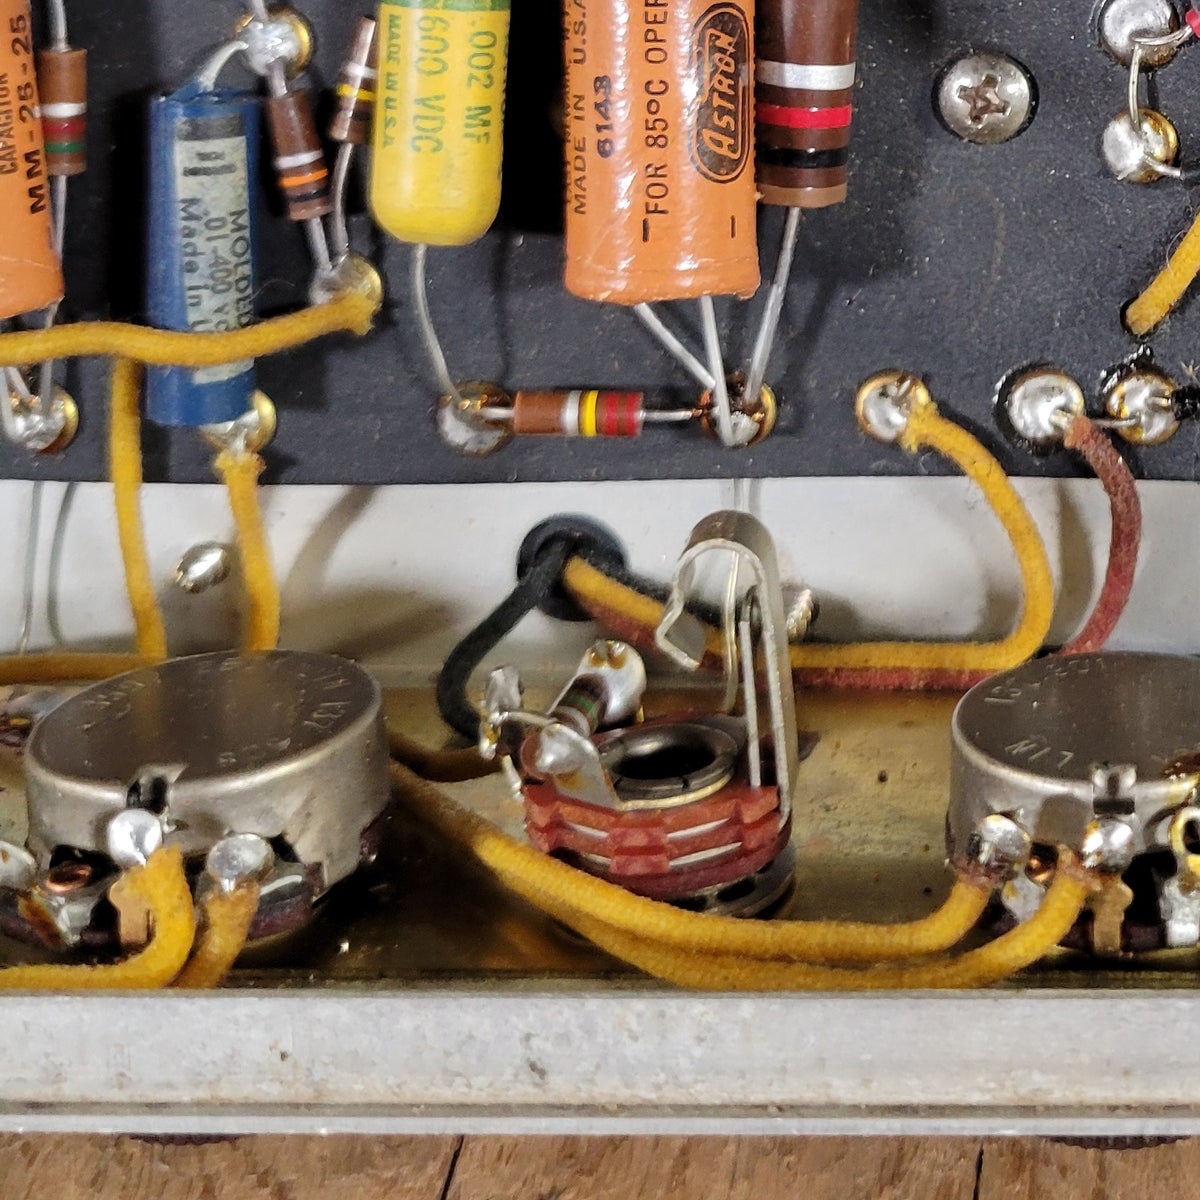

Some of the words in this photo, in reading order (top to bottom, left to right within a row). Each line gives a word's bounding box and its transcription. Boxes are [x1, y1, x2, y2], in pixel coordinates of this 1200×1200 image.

[386, 14, 402, 64] MADE
[414, 15, 450, 77] 600
[385, 72, 399, 92] IN
[573, 94, 587, 121] IN
[410, 94, 446, 155] VDC
[463, 105, 493, 145] MF
[592, 74, 614, 158] 6143
[573, 136, 587, 215] MADE
[644, 163, 669, 215] FOR
[179, 198, 203, 274] Made
